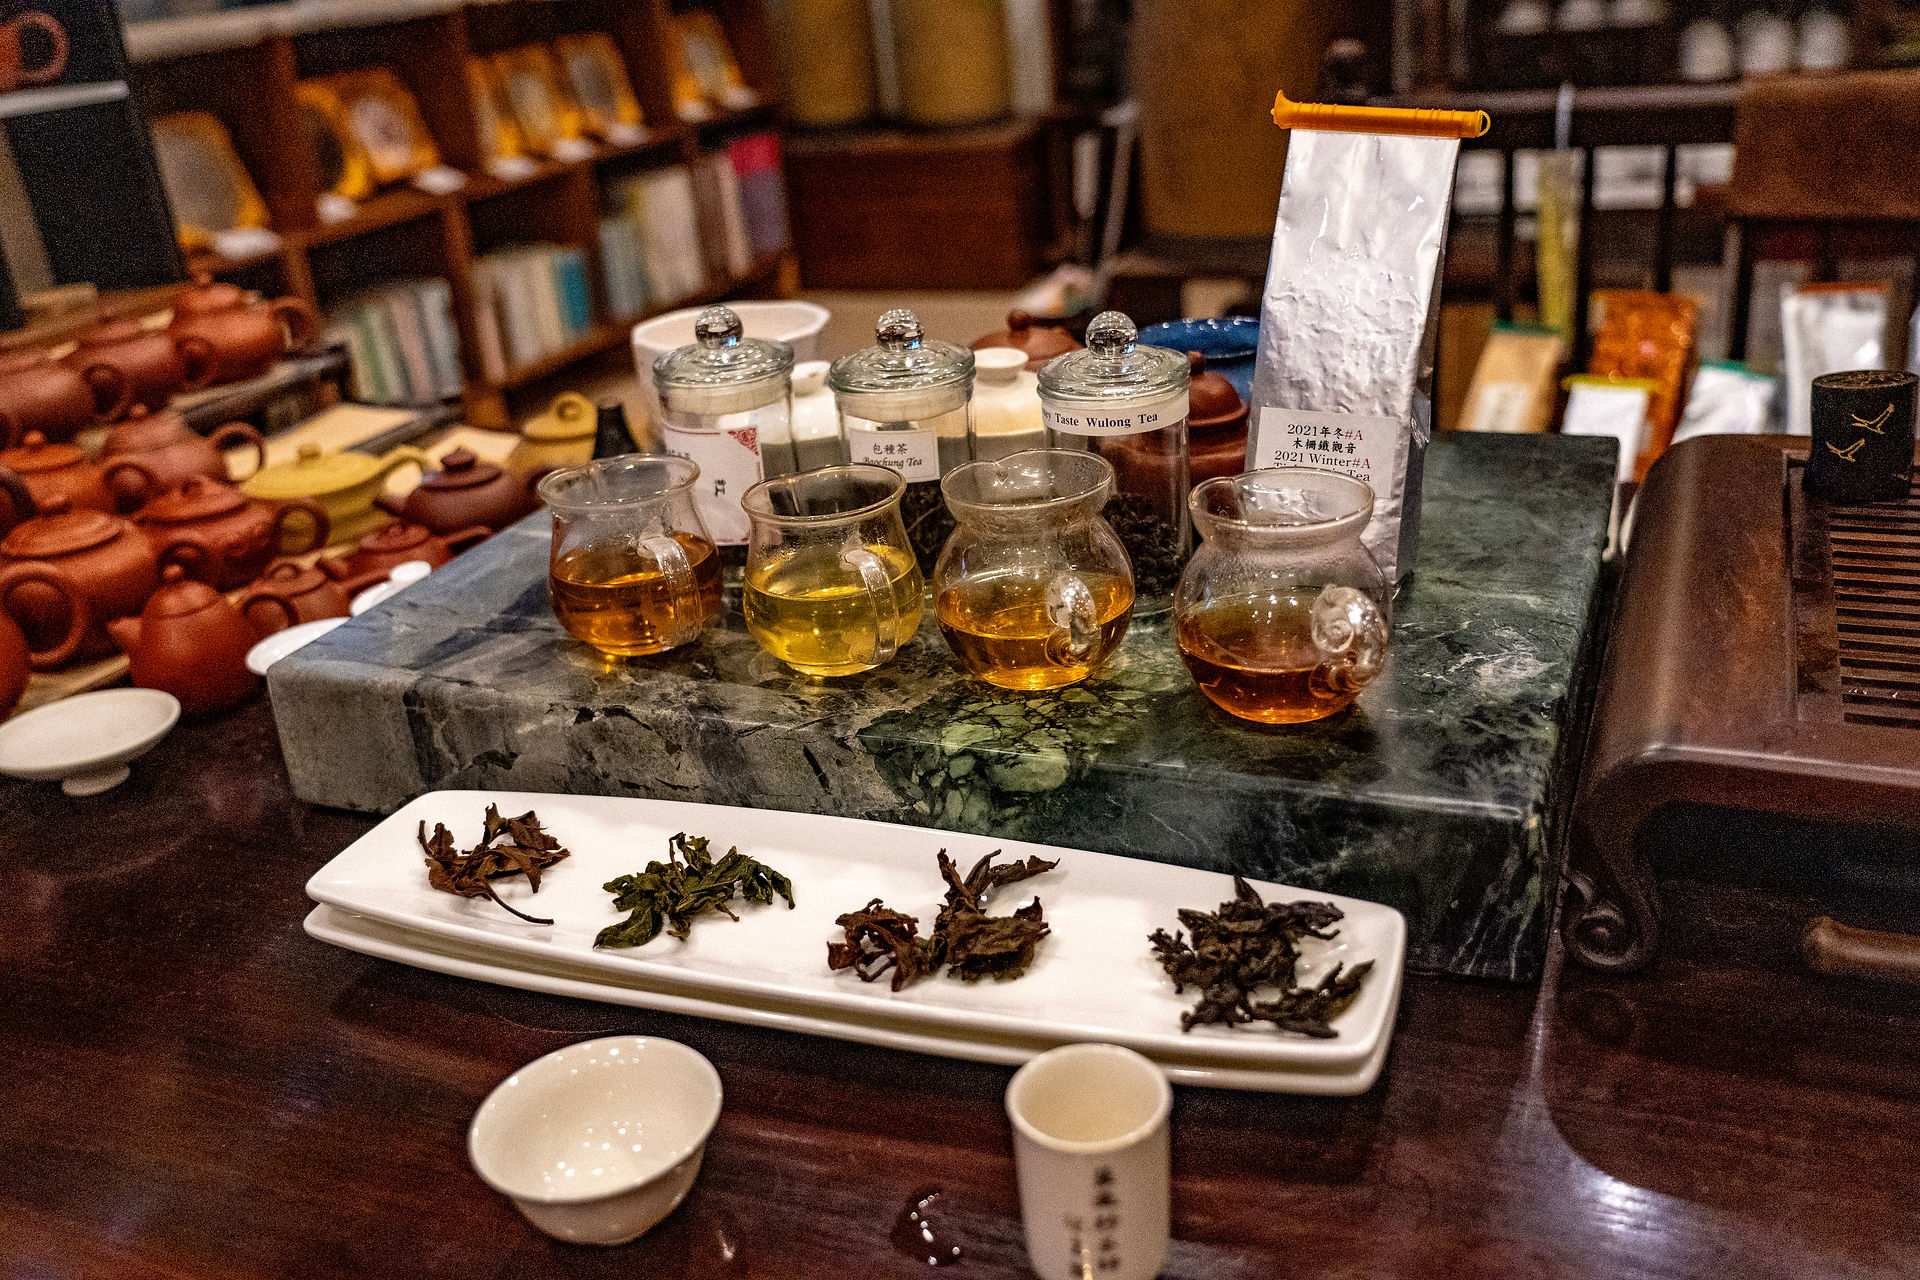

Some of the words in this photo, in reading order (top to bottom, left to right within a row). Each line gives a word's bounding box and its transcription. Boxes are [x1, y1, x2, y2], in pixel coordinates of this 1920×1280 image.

[1055, 412, 1079, 427] Taste
[1086, 417, 1131, 428] Wulong
[1138, 413, 1158, 424] Tea
[873, 443, 908, 455] 包種茶
[906, 457, 923, 466] Tea
[1274, 450, 1304, 463] 2021
[1347, 469, 1370, 482] Tea
